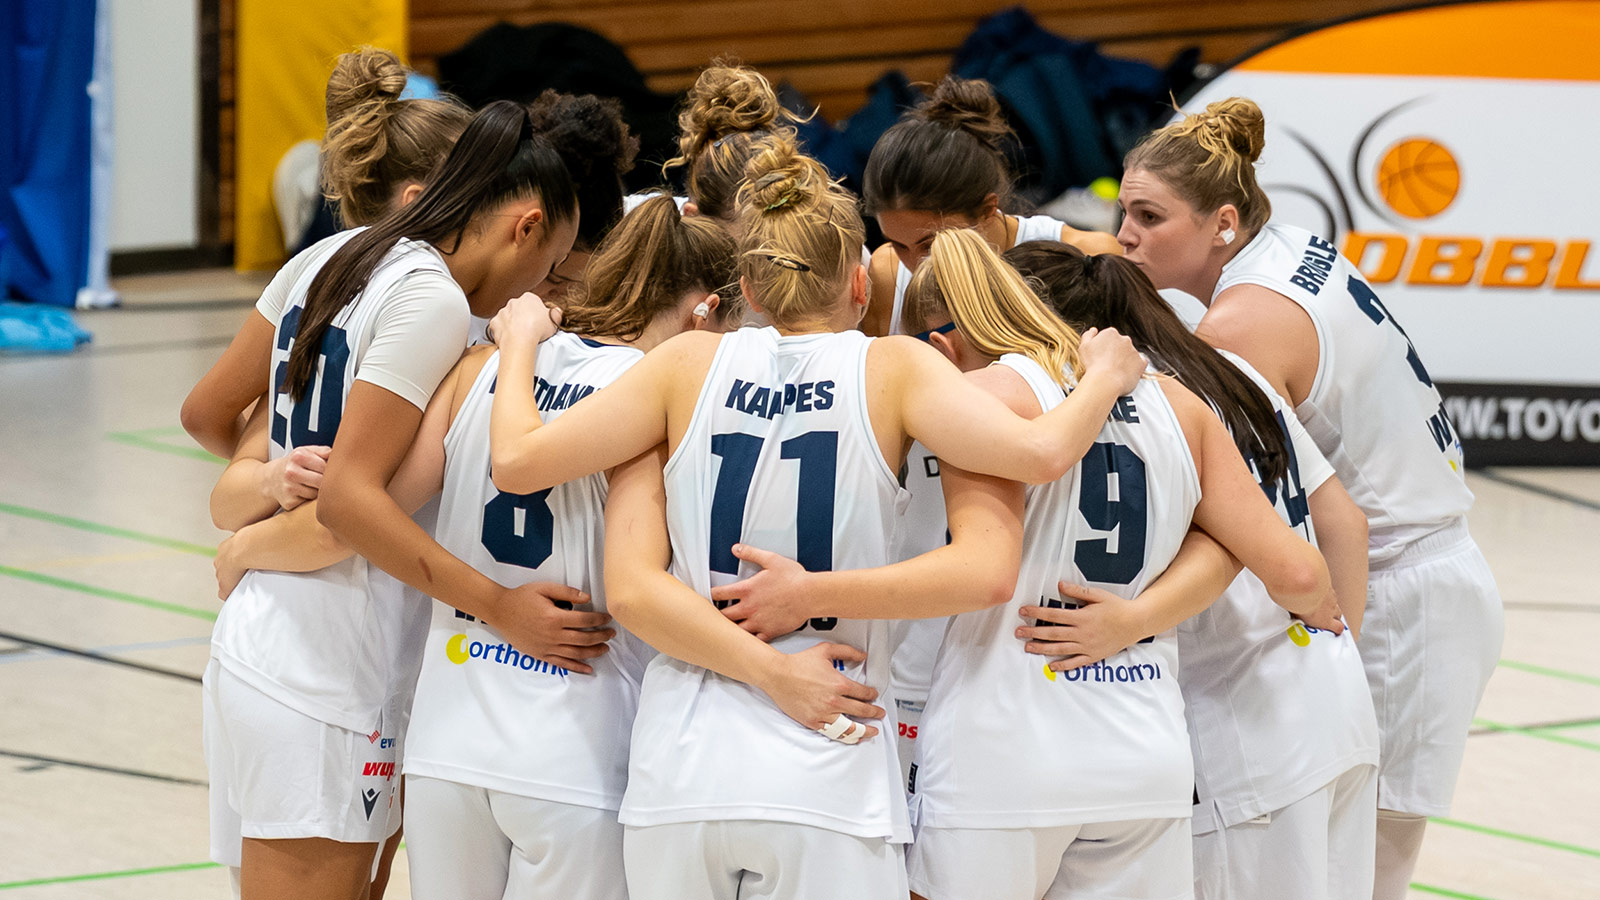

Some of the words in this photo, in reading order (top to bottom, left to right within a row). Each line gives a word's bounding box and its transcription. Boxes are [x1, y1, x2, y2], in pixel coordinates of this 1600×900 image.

[1342, 233, 1600, 290] DBBL
[709, 431, 838, 575] 11
[1074, 441, 1147, 585] 9
